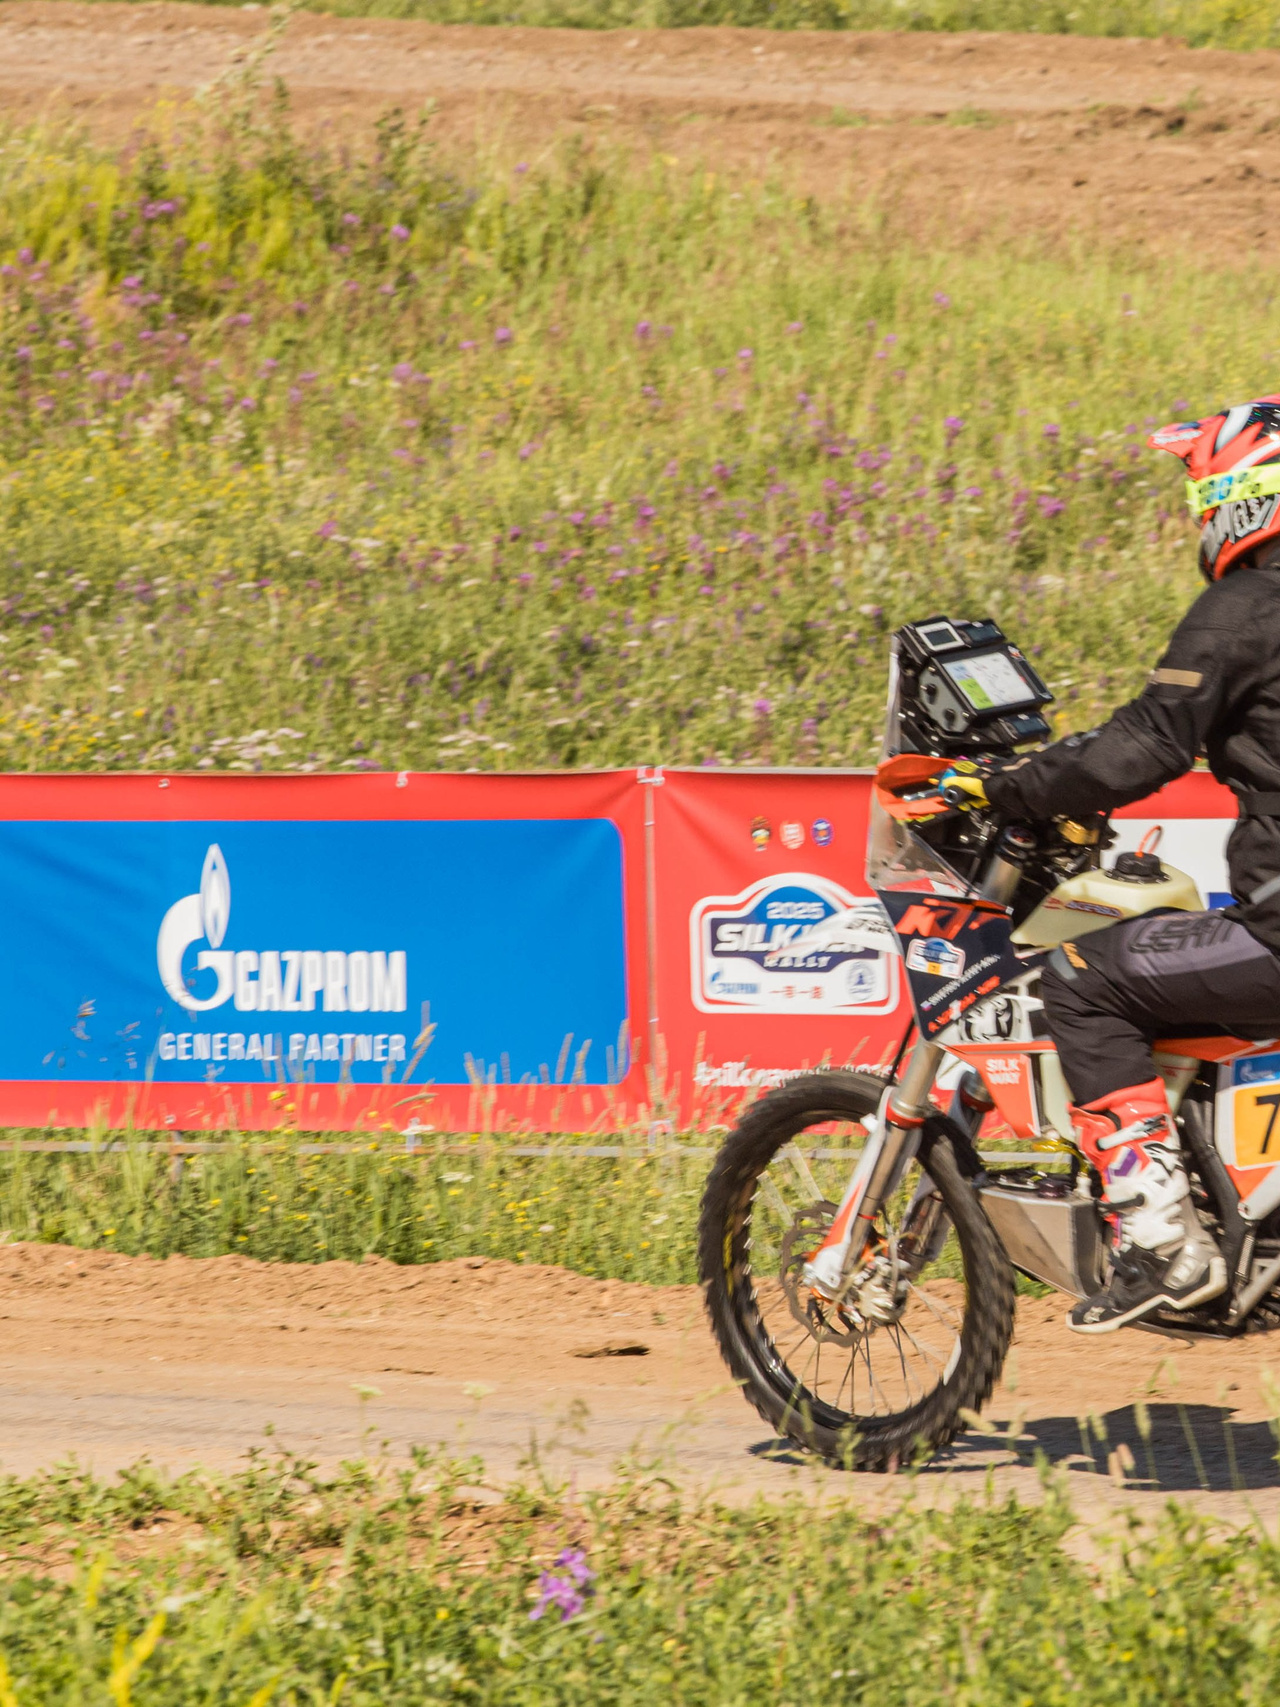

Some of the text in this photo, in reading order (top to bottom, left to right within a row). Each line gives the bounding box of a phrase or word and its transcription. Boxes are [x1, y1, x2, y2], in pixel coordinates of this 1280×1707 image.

[765, 901, 825, 920] 2025
[763, 956, 831, 969] RALLY
[234, 950, 408, 1012] GAZPROM
[158, 1033, 407, 1062] GENERAL PARTNER
[986, 1058, 1020, 1072] SILK
[987, 1072, 1021, 1085] WAY
